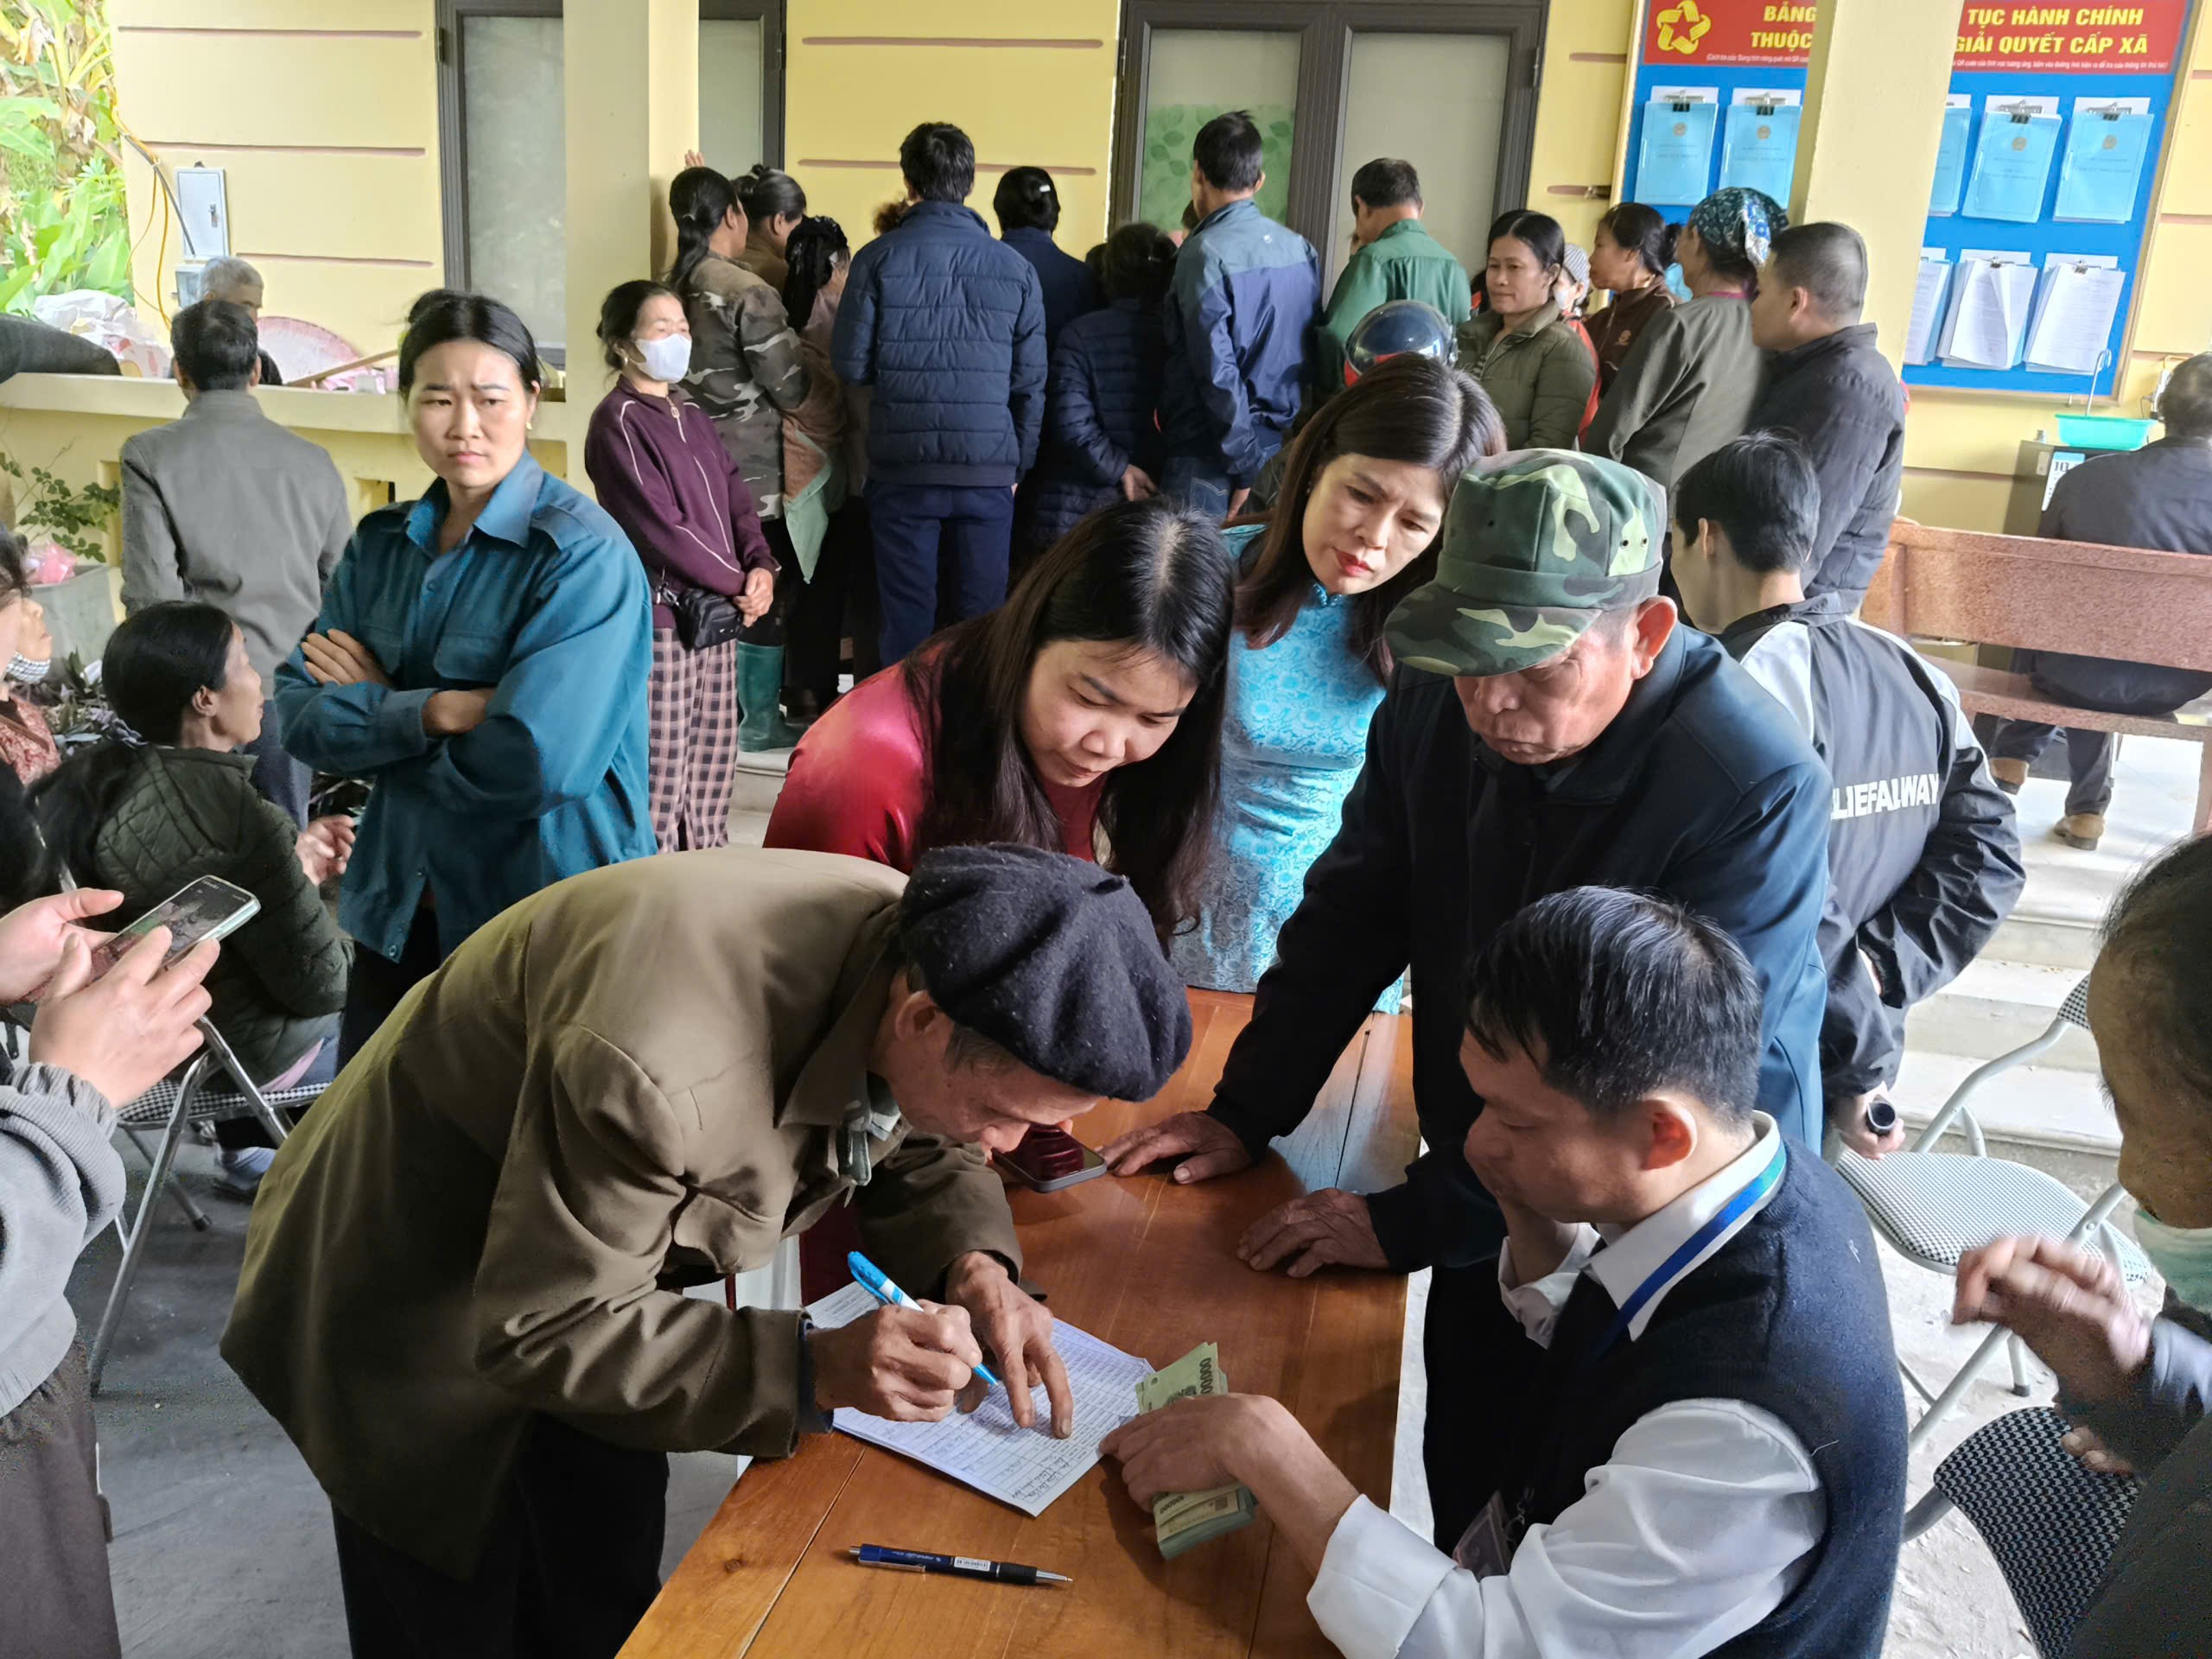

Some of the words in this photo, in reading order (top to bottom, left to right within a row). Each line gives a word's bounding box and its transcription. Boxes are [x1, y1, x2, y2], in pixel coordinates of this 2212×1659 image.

[1764, 1, 1817, 22] BẢNG
[1967, 9, 2005, 29] TỤC
[2011, 5, 2070, 26] HÀNH
[2075, 5, 2144, 26] CHÍNH
[1751, 29, 1814, 52] THUỘC
[1999, 31, 2065, 54] QUYẾT
[2069, 31, 2113, 54] CẤP
[2118, 34, 2148, 54] XÃ
[1831, 773, 1939, 821] LIEFALWAY
